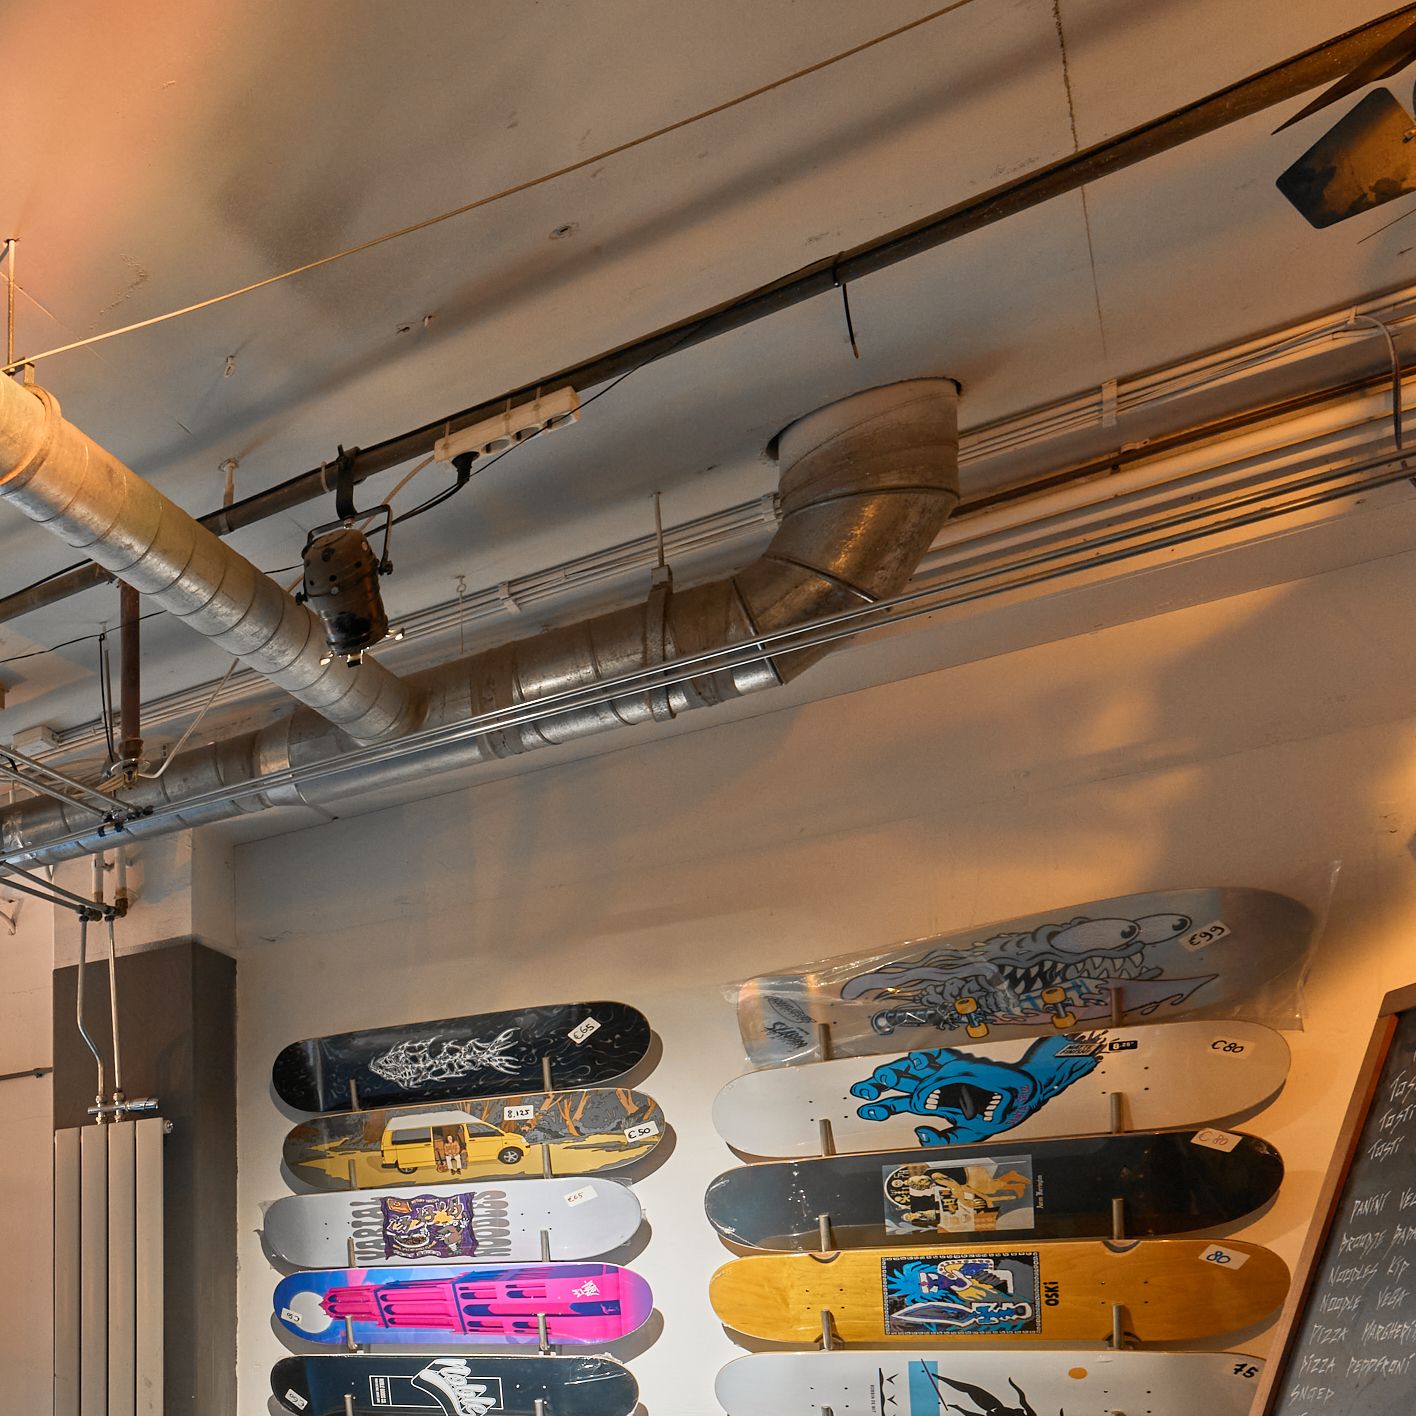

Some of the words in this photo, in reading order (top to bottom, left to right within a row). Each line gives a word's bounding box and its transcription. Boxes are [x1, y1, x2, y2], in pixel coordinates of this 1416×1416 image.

[1188, 925, 1225, 946] €99
[574, 1021, 596, 1040] €65
[1211, 1040, 1245, 1053] €80
[506, 1108, 531, 1119] 8.125
[628, 1127, 651, 1139] €50
[1198, 1130, 1229, 1146] €80
[1368, 1136, 1405, 1162] TOSTI
[1350, 1190, 1391, 1224] PANINI
[1206, 1250, 1231, 1264] 80
[1328, 1263, 1379, 1288] NOODLES
[1387, 1256, 1411, 1283] KIP
[1320, 1293, 1363, 1320] NOODLE
[1376, 1286, 1411, 1312] VEGA
[1309, 1323, 1348, 1345] PIZZA
[1233, 1362, 1259, 1379] 75
[1299, 1354, 1336, 1378] PIZZA
